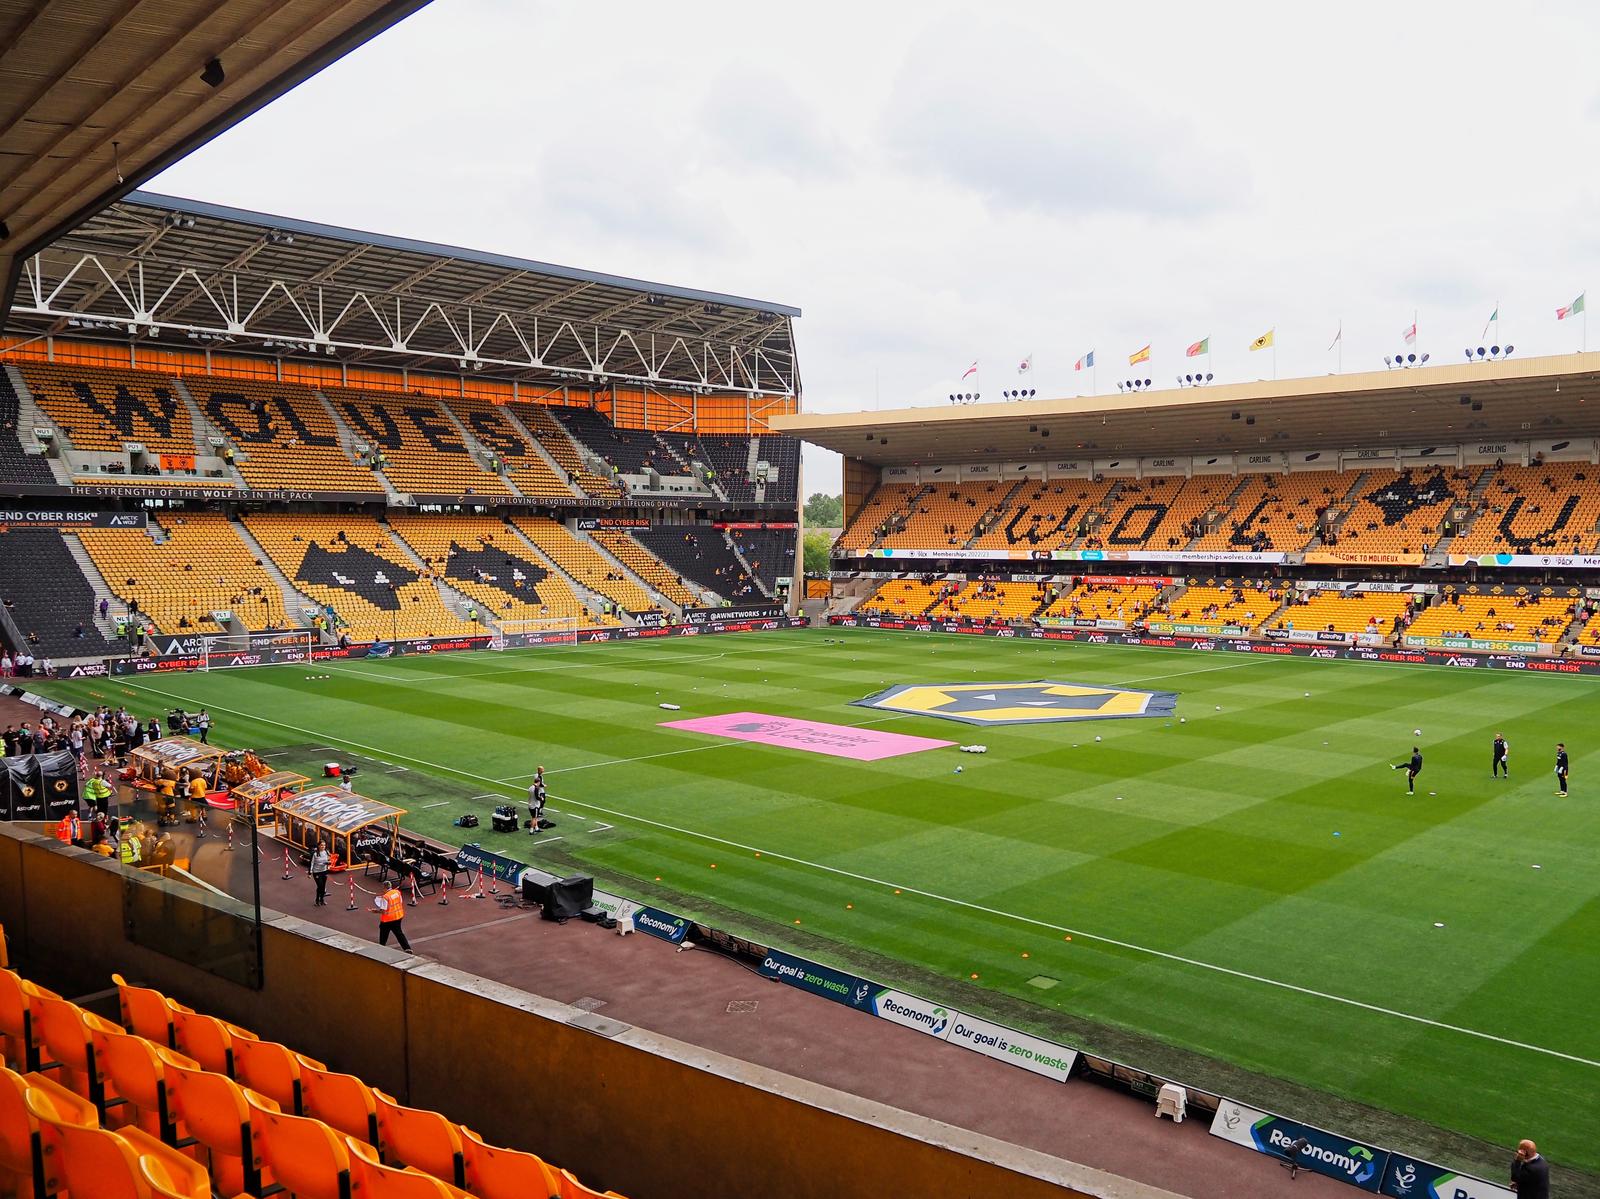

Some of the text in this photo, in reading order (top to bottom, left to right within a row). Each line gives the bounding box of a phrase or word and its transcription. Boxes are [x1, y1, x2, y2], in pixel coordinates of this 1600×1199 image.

[1478, 445, 1506, 454] CARLING
[1057, 462, 1077, 470] CARLING
[1153, 459, 1174, 467] CARLING
[889, 467, 907, 476] CARLING
[69, 487, 91, 495] THE
[97, 487, 155, 496] STRENGTH
[160, 489, 173, 497] OF
[178, 489, 198, 497] THE
[203, 490, 233, 498] WOLF
[252, 491, 263, 499] IN
[268, 491, 285, 499] THE
[490, 496, 506, 504] OUR
[509, 497, 537, 505] LOVING
[540, 498, 577, 506] DEVOTION
[624, 500, 655, 508] LIFELONG
[0, 511, 23, 521] END
[26, 511, 63, 521] CYBER
[1369, 583, 1395, 591] CARLING
[710, 610, 760, 620] @AWNETWORKS
[1193, 625, 1241, 635] bet365.com
[272, 637, 298, 645] CYBER
[1407, 637, 1537, 652] bet365.com bet365.com
[1252, 645, 1275, 653] CYBER
[1379, 653, 1405, 661] CYBER
[1527, 662, 1557, 670] CYBER
[355, 835, 390, 848] AstroPay
[600, 901, 617, 913] waste
[639, 913, 678, 936] Reconomy
[764, 957, 780, 971] Our
[778, 964, 798, 977] goal
[804, 973, 823, 986] zero
[823, 979, 849, 995] waste
[883, 998, 939, 1028] Reconomy
[954, 1023, 974, 1039] Our
[973, 1032, 999, 1047] goal
[1008, 1044, 1033, 1059] zero
[1034, 1052, 1068, 1071] waste
